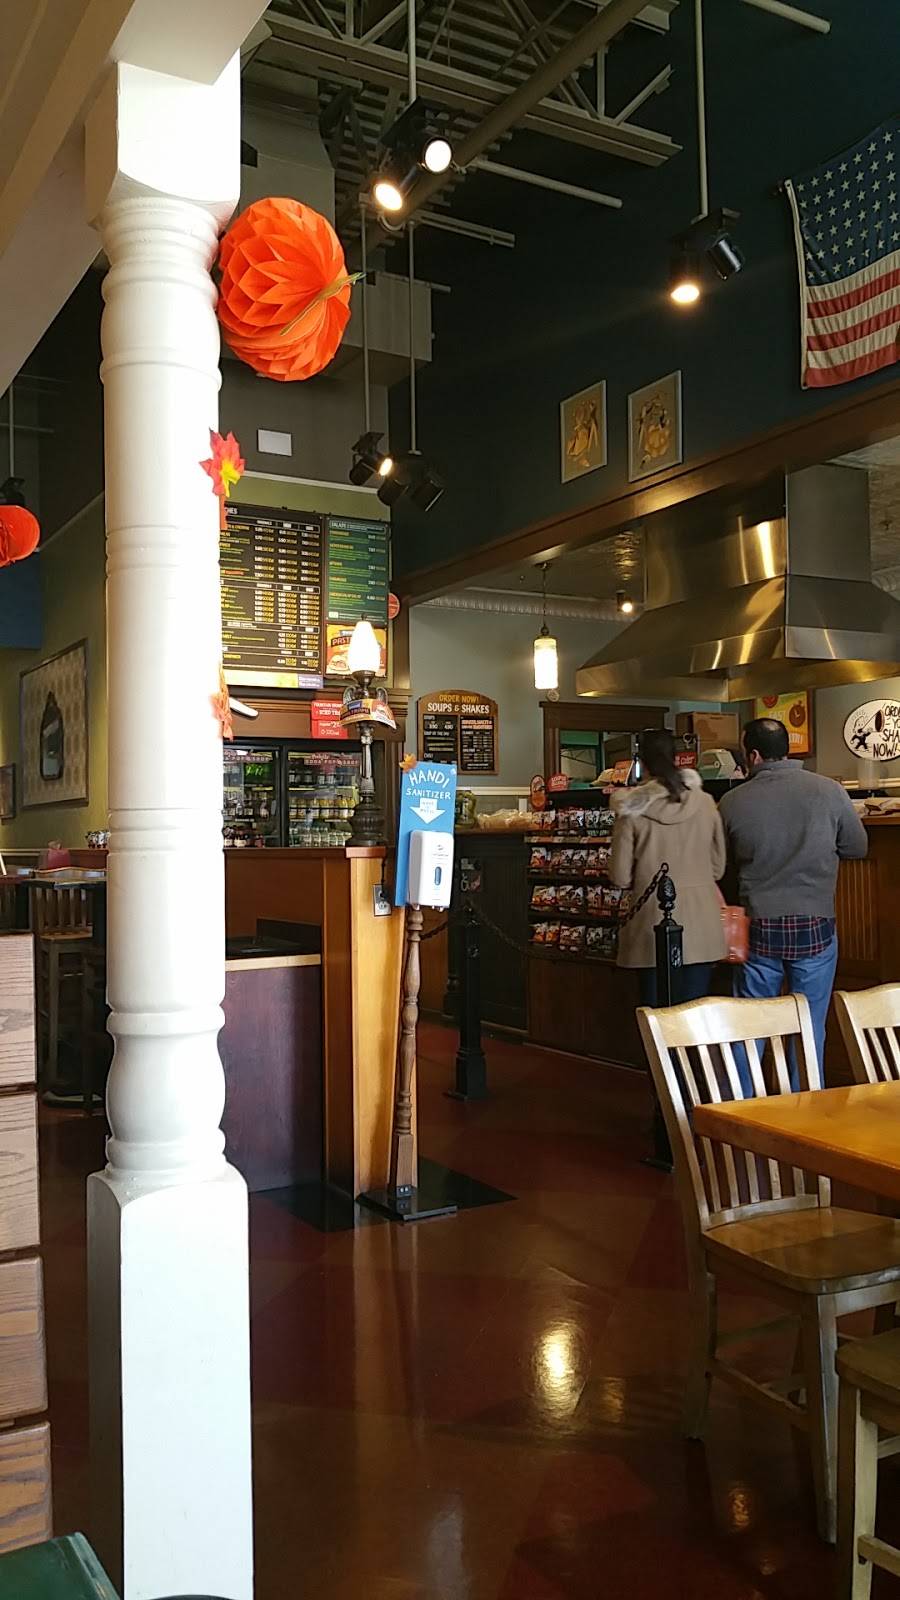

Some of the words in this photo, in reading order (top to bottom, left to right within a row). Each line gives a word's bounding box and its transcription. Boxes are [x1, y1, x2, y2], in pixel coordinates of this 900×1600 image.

[439, 694, 460, 703] ORDER
[461, 695, 479, 703] NOW!
[427, 702, 452, 712] SOUPS
[454, 704, 460, 712] &
[461, 704, 490, 714] SHAKES
[873, 743, 898, 758] NOW!
[408, 769, 450, 788] HANDI
[406, 788, 452, 800] SANITIZER
